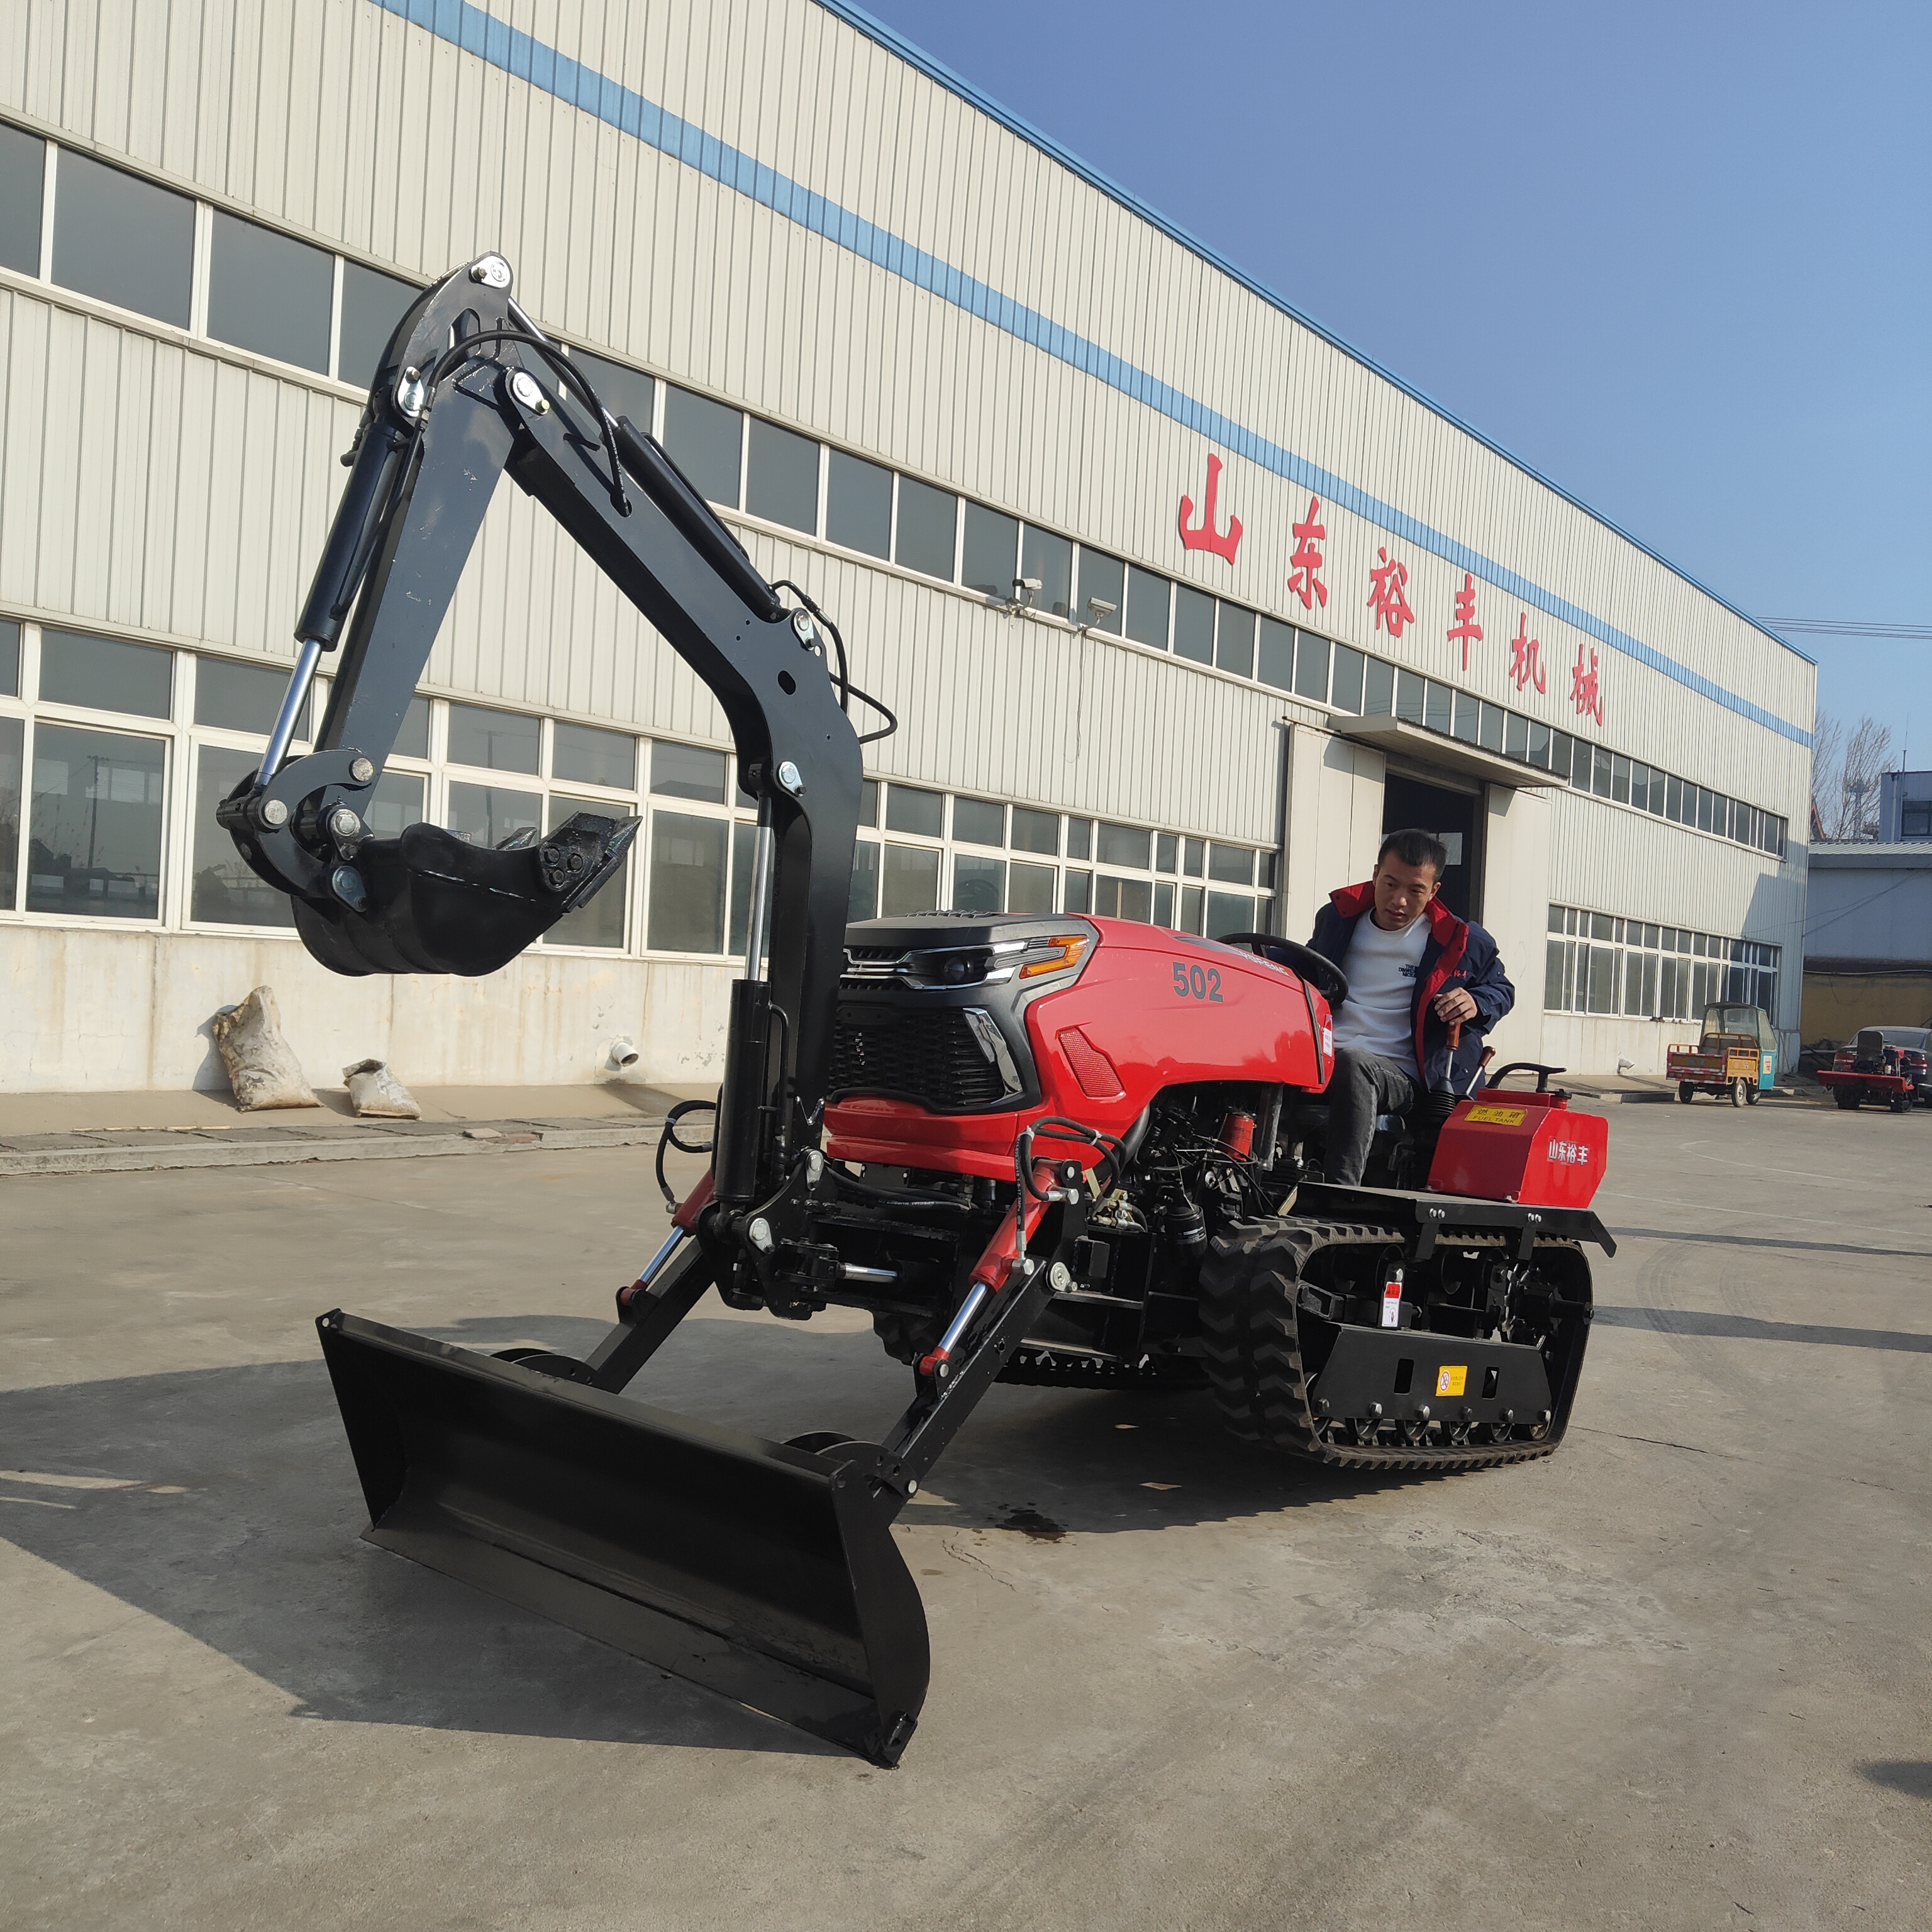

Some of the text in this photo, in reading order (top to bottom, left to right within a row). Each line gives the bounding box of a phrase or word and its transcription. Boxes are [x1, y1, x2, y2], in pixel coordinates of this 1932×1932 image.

[1179, 453, 1603, 727] 山东裕丰机械
[1172, 962, 1224, 1003] 502
[1548, 1138, 1589, 1166] 山东裕丰
